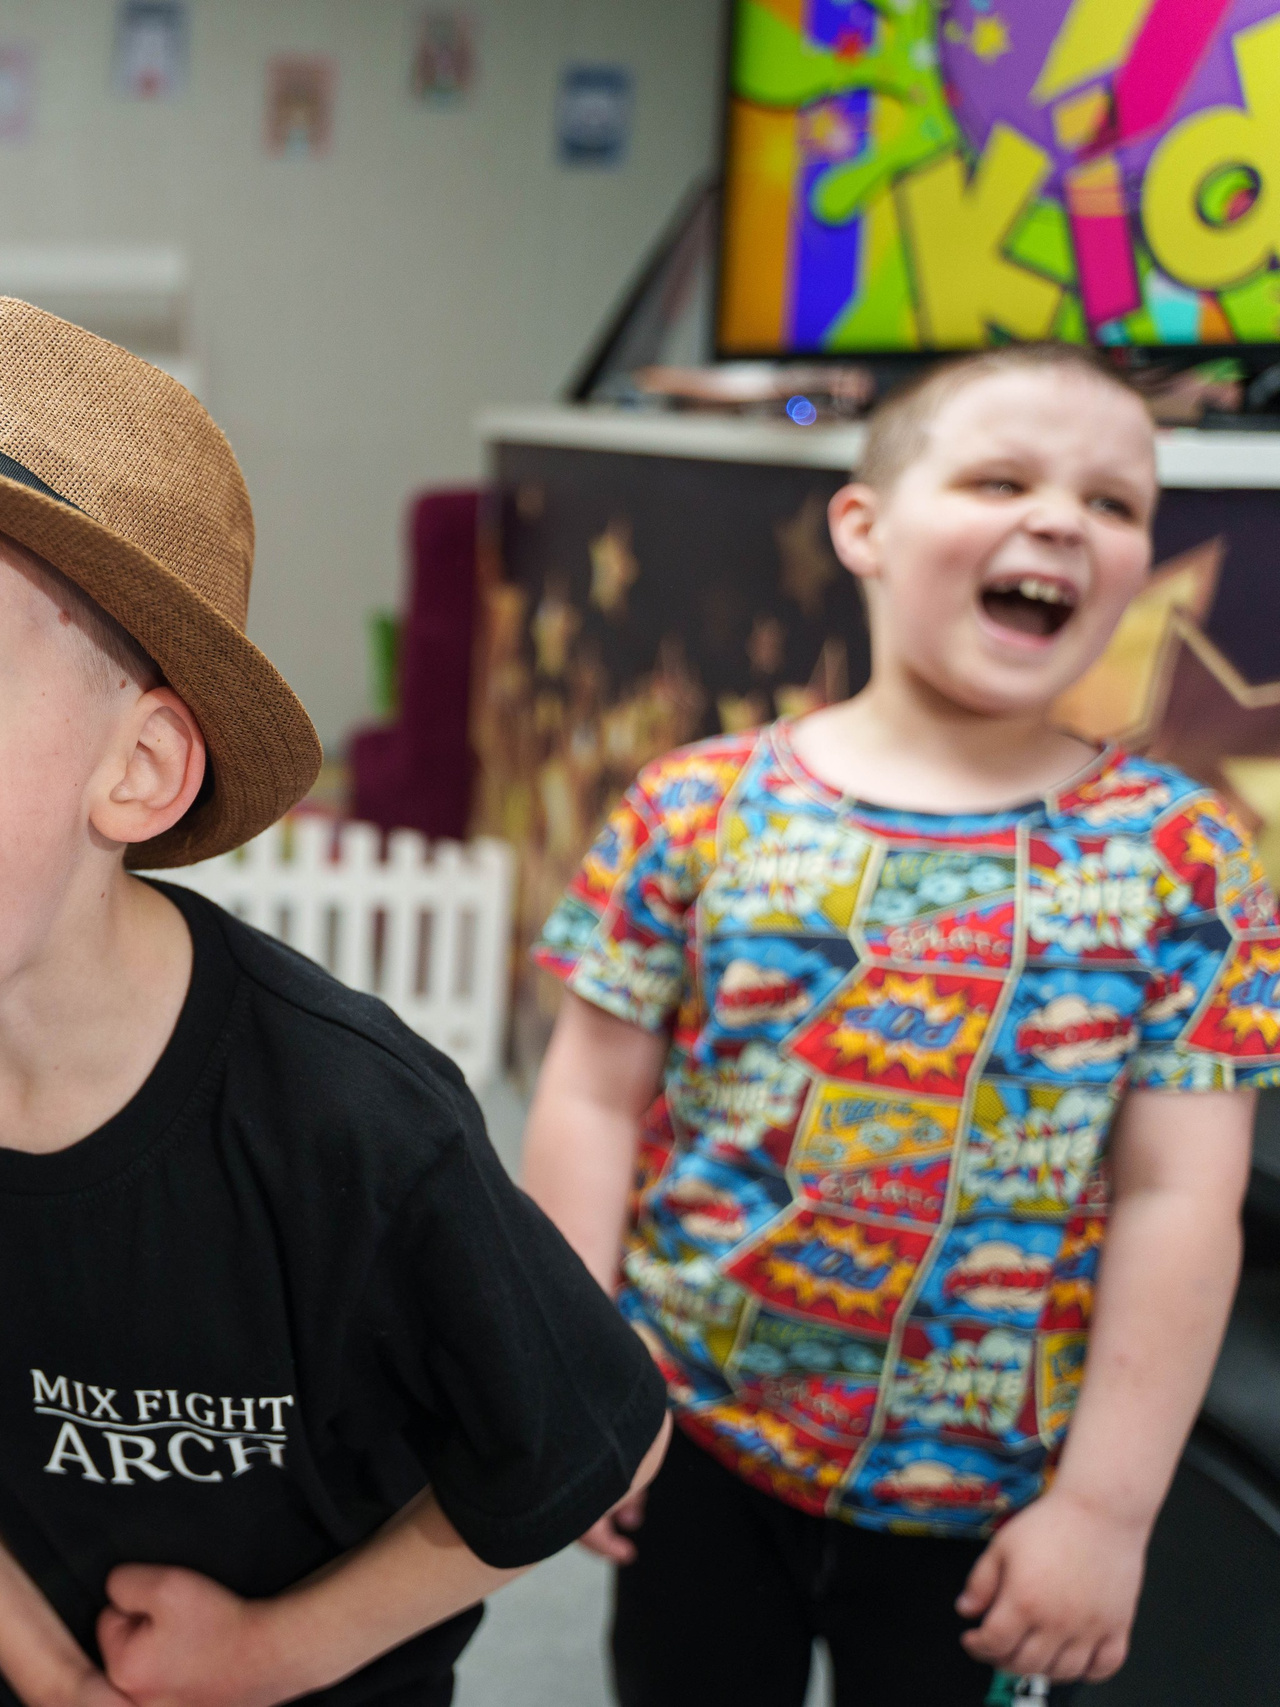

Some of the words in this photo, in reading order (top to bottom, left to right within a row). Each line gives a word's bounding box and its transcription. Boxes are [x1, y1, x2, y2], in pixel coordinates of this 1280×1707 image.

[30, 1369, 123, 1421] MIX
[134, 1389, 294, 1432] FIGHT
[43, 1421, 287, 1486] ARCH
